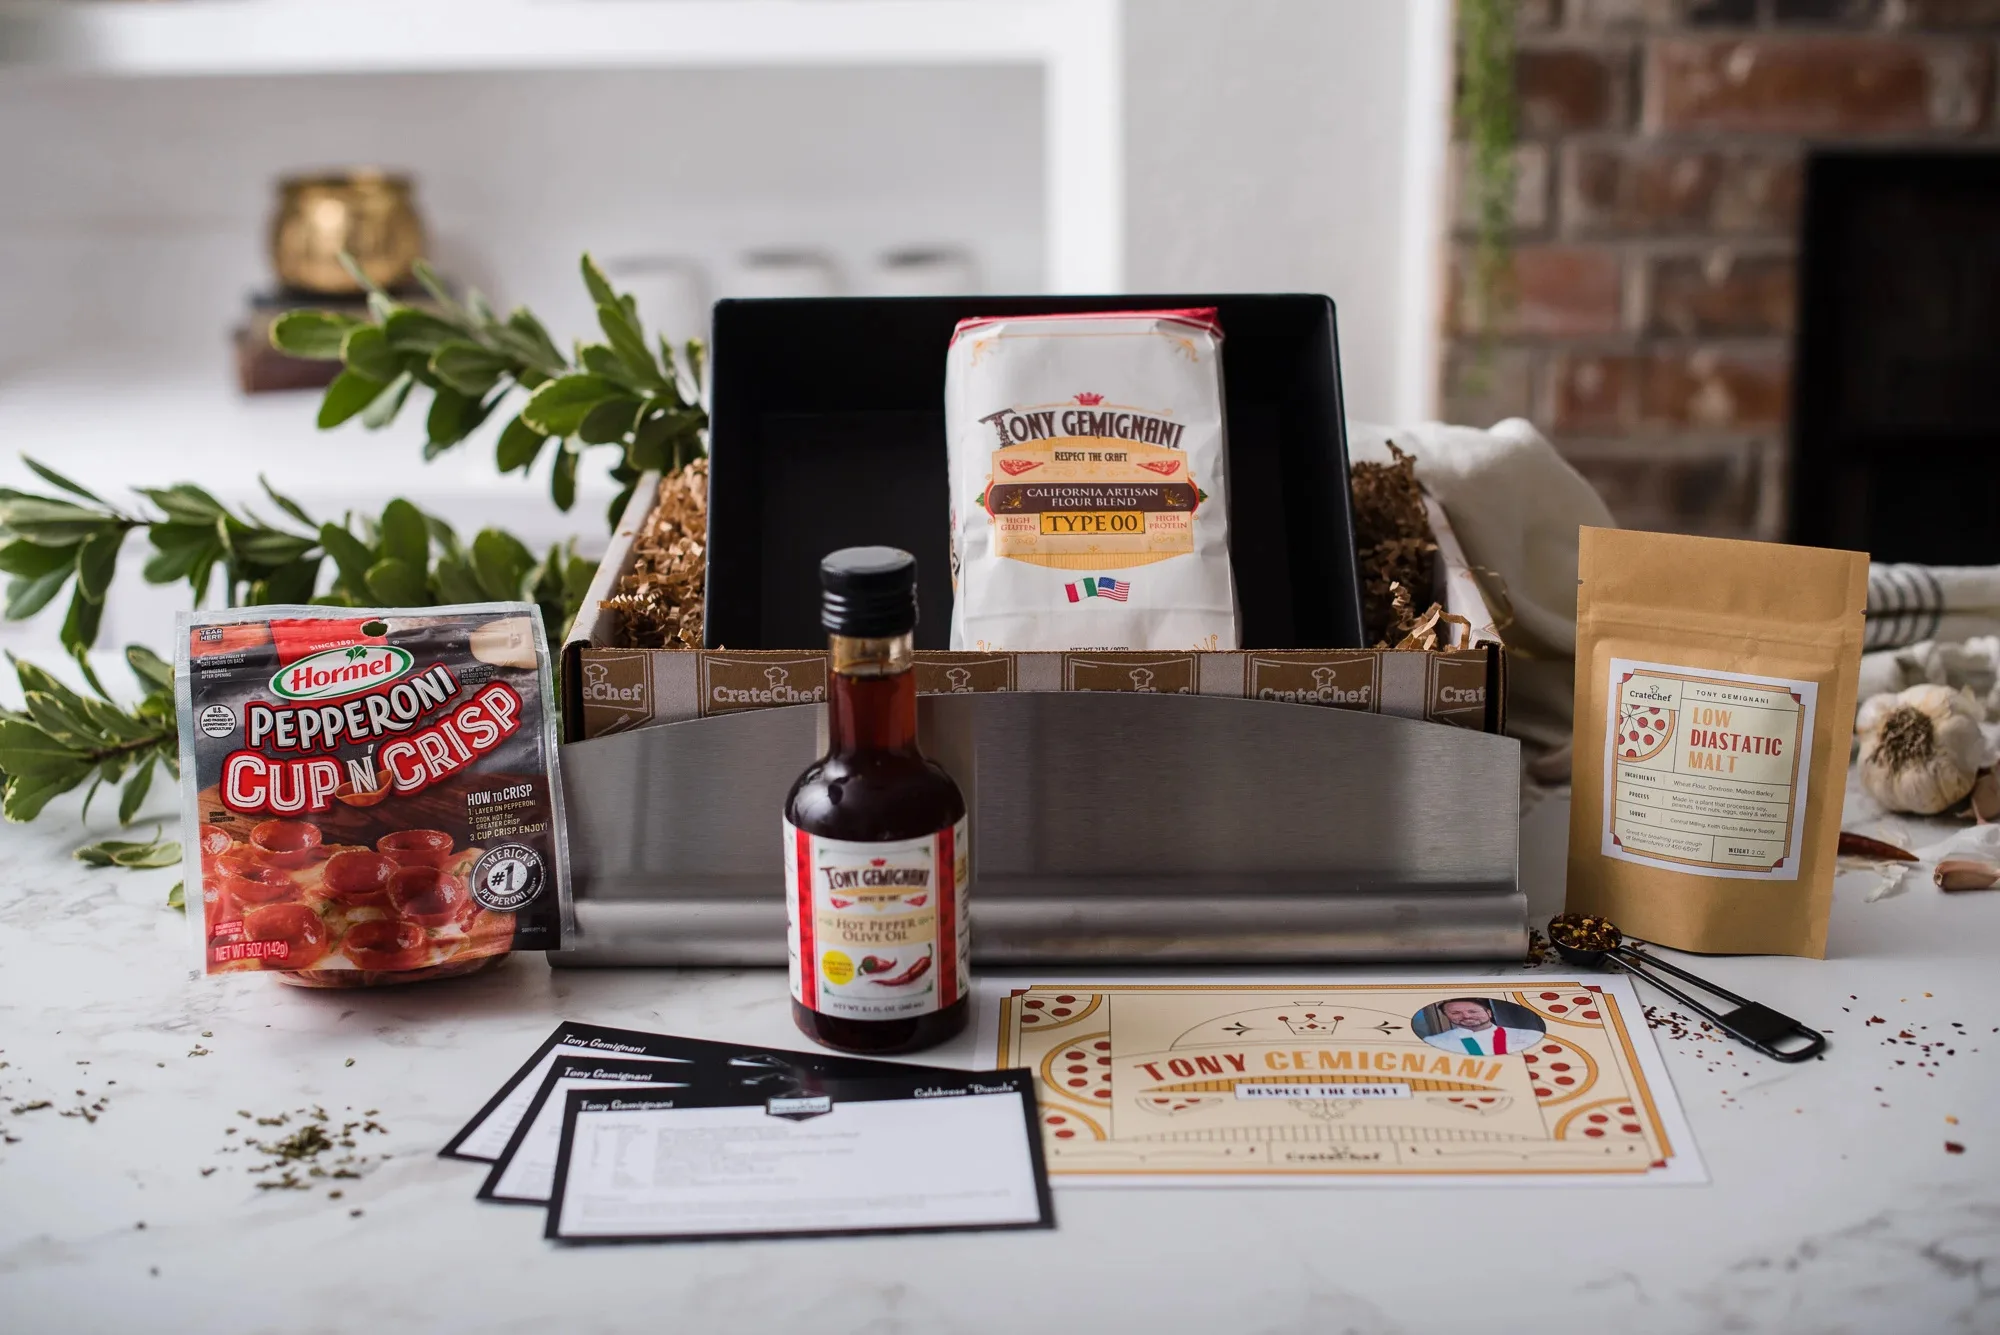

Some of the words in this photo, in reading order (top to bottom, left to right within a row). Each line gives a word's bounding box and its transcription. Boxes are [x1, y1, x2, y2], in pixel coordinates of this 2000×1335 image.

[979, 409, 1057, 449] TONY
[1062, 411, 1186, 450] GEMIGNANI
[1055, 452, 1085, 462] RESPECT
[1088, 452, 1102, 462] THE
[1105, 452, 1127, 462] CRAFT
[1027, 488, 1102, 497] CALIFORNIA
[1106, 487, 1158, 497] ARTISAN
[1052, 497, 1092, 507] FLOUR
[1096, 497, 1137, 507] BLEND
[1046, 515, 1107, 531] TYPE
[1155, 514, 1180, 522] HIGH
[1000, 523, 1036, 531] GLUTEN
[1149, 521, 1188, 530] PROTEIN
[309, 642, 335, 650] SINCE
[291, 653, 391, 691] Hormel
[713, 686, 824, 703] CrateChef
[1259, 686, 1370, 703] CrateChef
[1629, 690, 1672, 702] CrateChef
[1696, 690, 1717, 698] TONY
[1722, 693, 1769, 704] GEMIGNANI
[251, 666, 456, 749] PEPPERONI
[1692, 707, 1732, 728] LOW
[227, 755, 340, 811] CUP
[383, 687, 516, 791] CRISP
[1690, 729, 1783, 756] DIASTATIC
[1688, 751, 1739, 773] MALT
[1624, 772, 1656, 782] INGREDIENTS
[467, 790, 491, 806] HOW
[492, 792, 502, 802] TO
[503, 784, 533, 800] CRISP
[1628, 791, 1650, 800] PROCESS
[1673, 780, 1691, 788] Wheat
[1756, 790, 1775, 798] Barley
[468, 808, 474, 816] 1.
[475, 806, 493, 815] LAYER
[495, 804, 503, 812] ON
[504, 800, 536, 810] PEPPERONI
[1629, 810, 1646, 818] SOURCE
[1726, 803, 1755, 811] processes
[476, 816, 491, 824] COOK
[476, 821, 502, 830] GREATER
[503, 818, 520, 826] CRISP
[519, 822, 548, 834] ENJOY!
[481, 848, 537, 871] AMERICA'S
[491, 862, 515, 892] #1
[819, 866, 859, 889] TONY
[480, 887, 527, 906] PEPPERONI
[836, 918, 865, 931] HOT
[870, 918, 917, 931] PEPPER
[842, 930, 881, 942] OLIVE
[885, 930, 909, 941] OIL
[215, 946, 231, 962] NET
[232, 943, 245, 958] WT
[264, 941, 288, 959] (142g)
[562, 1034, 588, 1047] Tony
[590, 1038, 647, 1053] Gemignani
[1134, 1053, 1246, 1082] TONY
[1263, 1050, 1504, 1082] GEMIGNANI
[564, 1067, 591, 1079] Tony
[592, 1068, 653, 1081] Gemignani
[1247, 1087, 1311, 1095] RESPECT
[1319, 1087, 1347, 1095] THE
[1352, 1087, 1399, 1095] CRAFT
[581, 1100, 609, 1111] Tony
[611, 1098, 674, 1111] Gemignani
